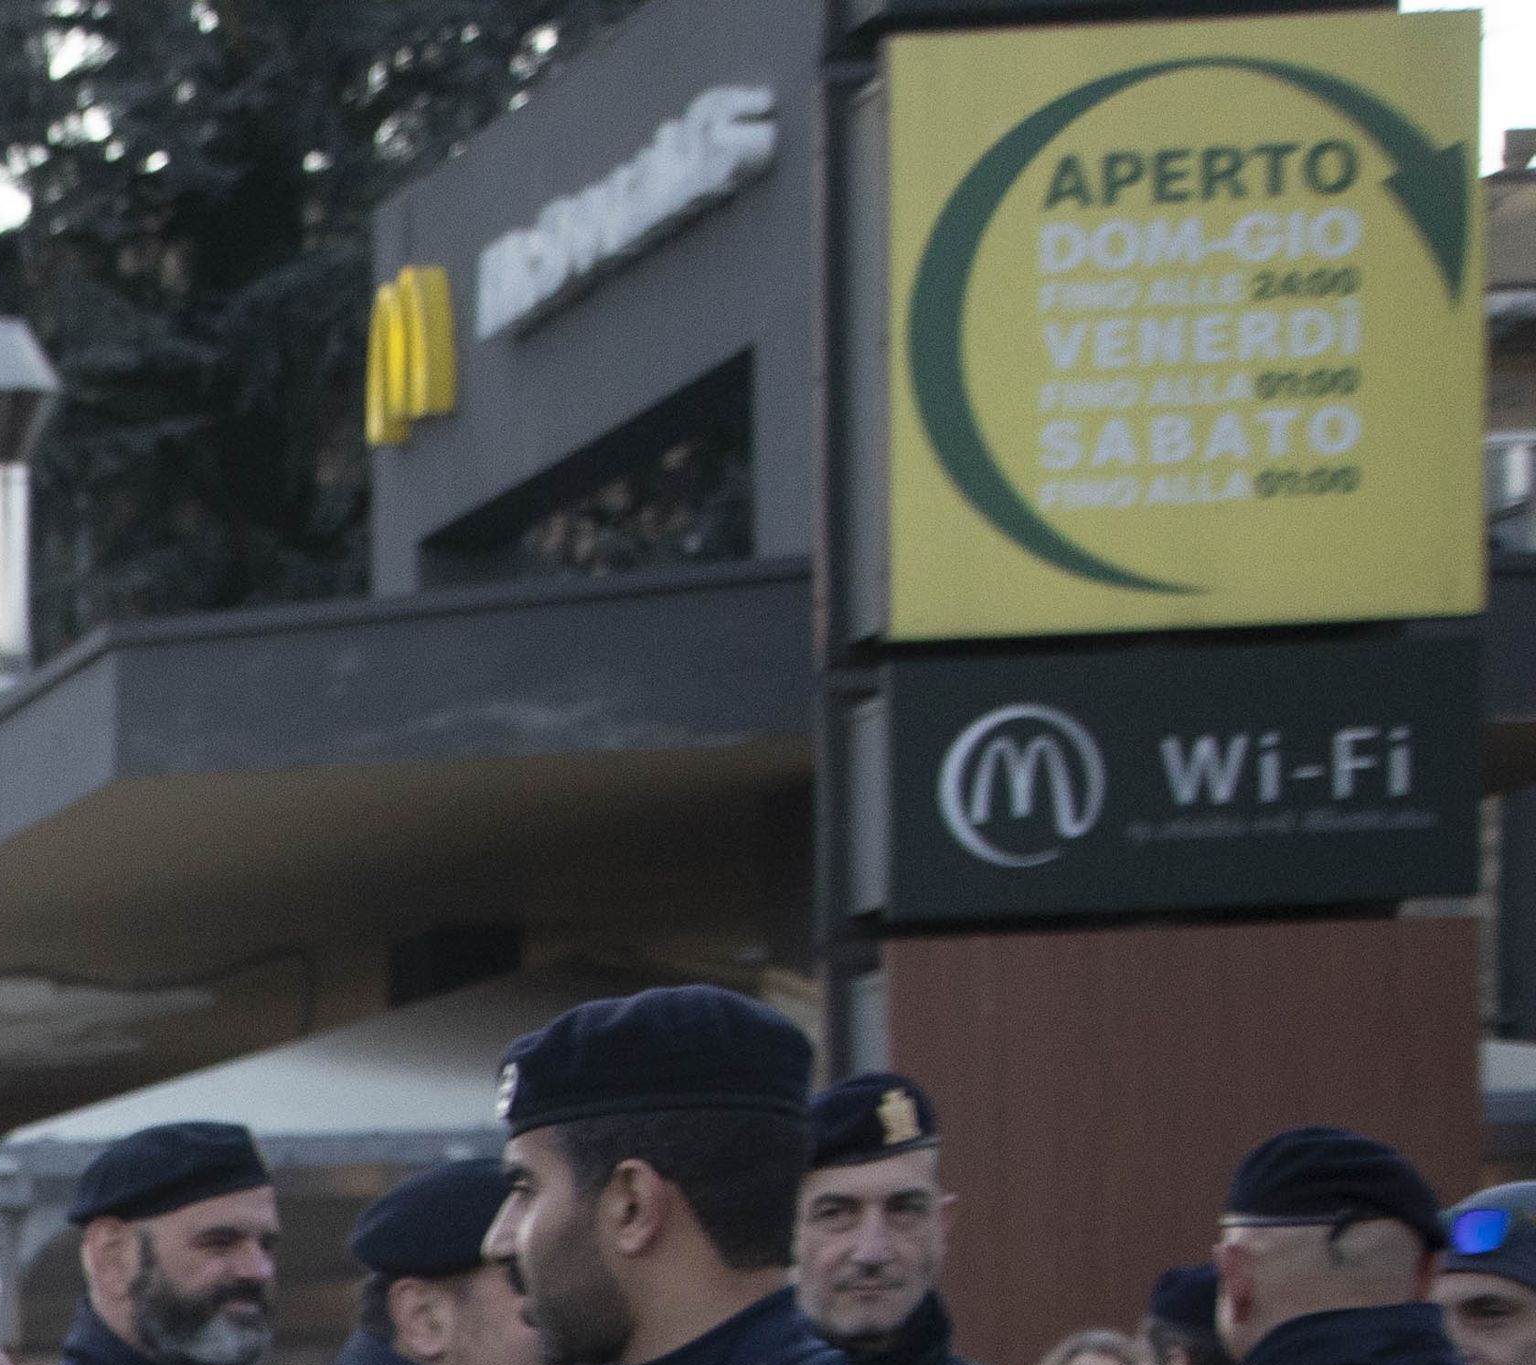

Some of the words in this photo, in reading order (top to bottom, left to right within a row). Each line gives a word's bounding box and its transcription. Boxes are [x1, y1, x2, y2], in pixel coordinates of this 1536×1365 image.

[1042, 138, 1359, 210] APERTO
[1039, 207, 1361, 273] DOM-GIO
[1040, 404, 1361, 470] SABATO
[1159, 726, 1412, 805] Wi-Fi
